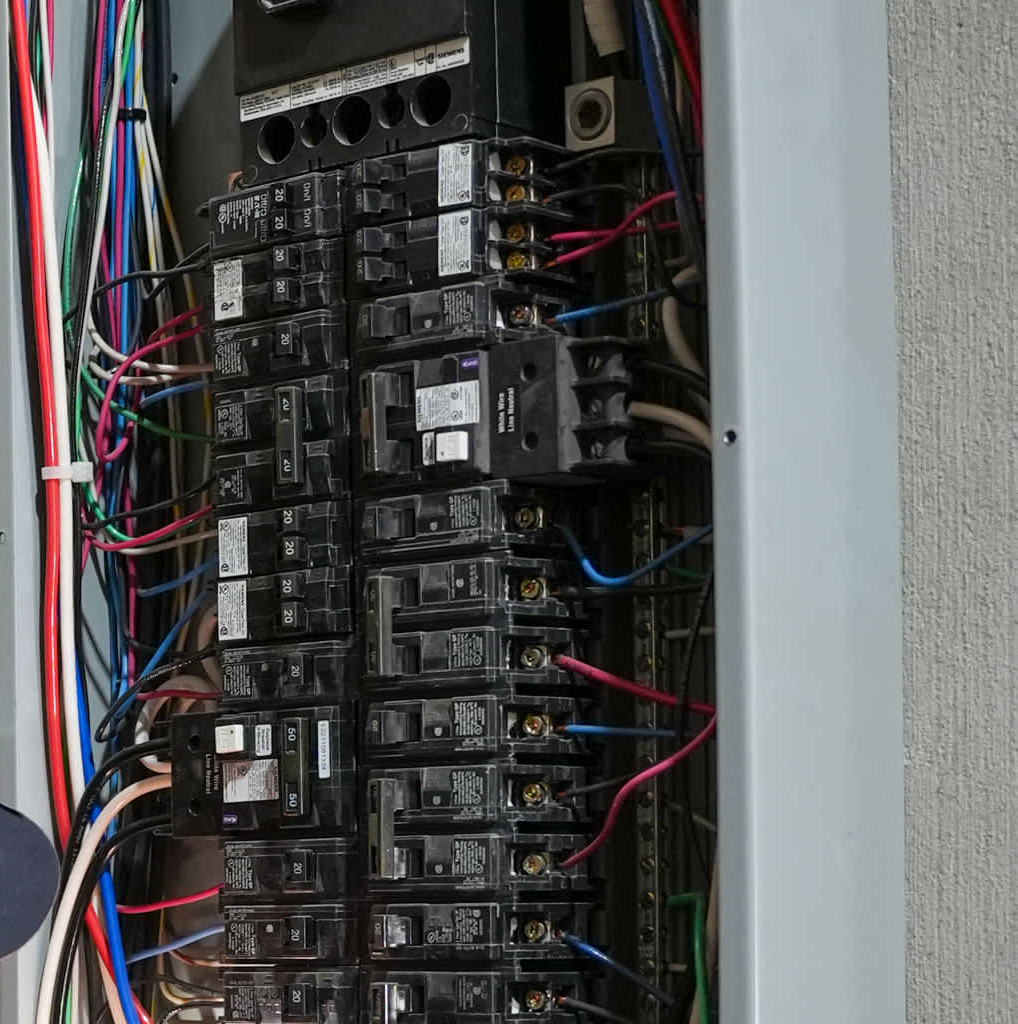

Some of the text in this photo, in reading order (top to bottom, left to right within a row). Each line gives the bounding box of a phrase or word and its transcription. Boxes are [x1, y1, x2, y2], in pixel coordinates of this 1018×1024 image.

[274, 188, 284, 202] 20
[274, 215, 284, 230] 20
[274, 249, 284, 262] 20
[276, 280, 286, 294] 20
[280, 333, 290, 345] 20
[507, 415, 515, 432] Line
[283, 510, 293, 525] 20
[285, 541, 295, 556] 20
[282, 579, 292, 594] 20
[283, 609, 294, 624] 20
[290, 665, 300, 678] 20
[293, 862, 303, 875] 20
[291, 928, 301, 942] 20
[292, 990, 302, 1004] 20
